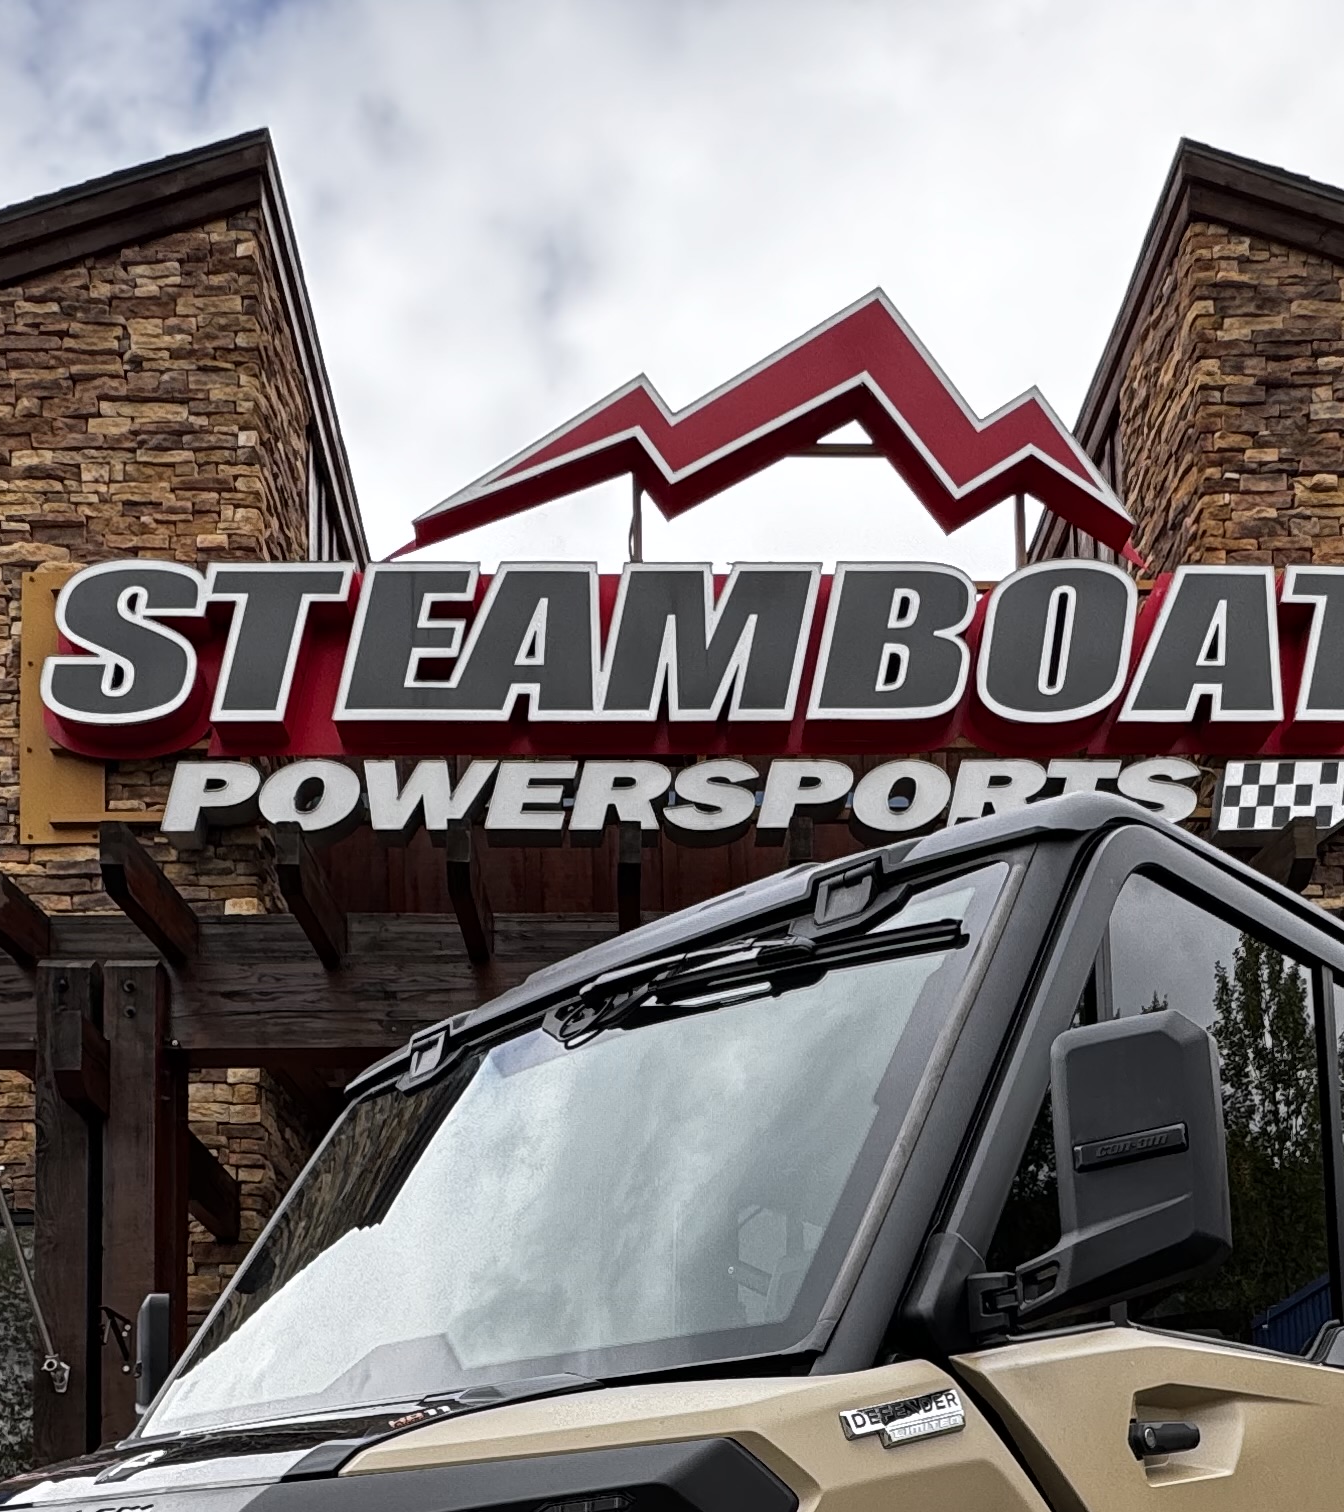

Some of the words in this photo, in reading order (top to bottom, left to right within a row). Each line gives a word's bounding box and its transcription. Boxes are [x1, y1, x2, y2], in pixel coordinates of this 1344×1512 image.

[159, 757, 1202, 832] POWERSPORTS
[851, 1391, 960, 1429] DEFENDER
[892, 1414, 961, 1440] LIMITED
